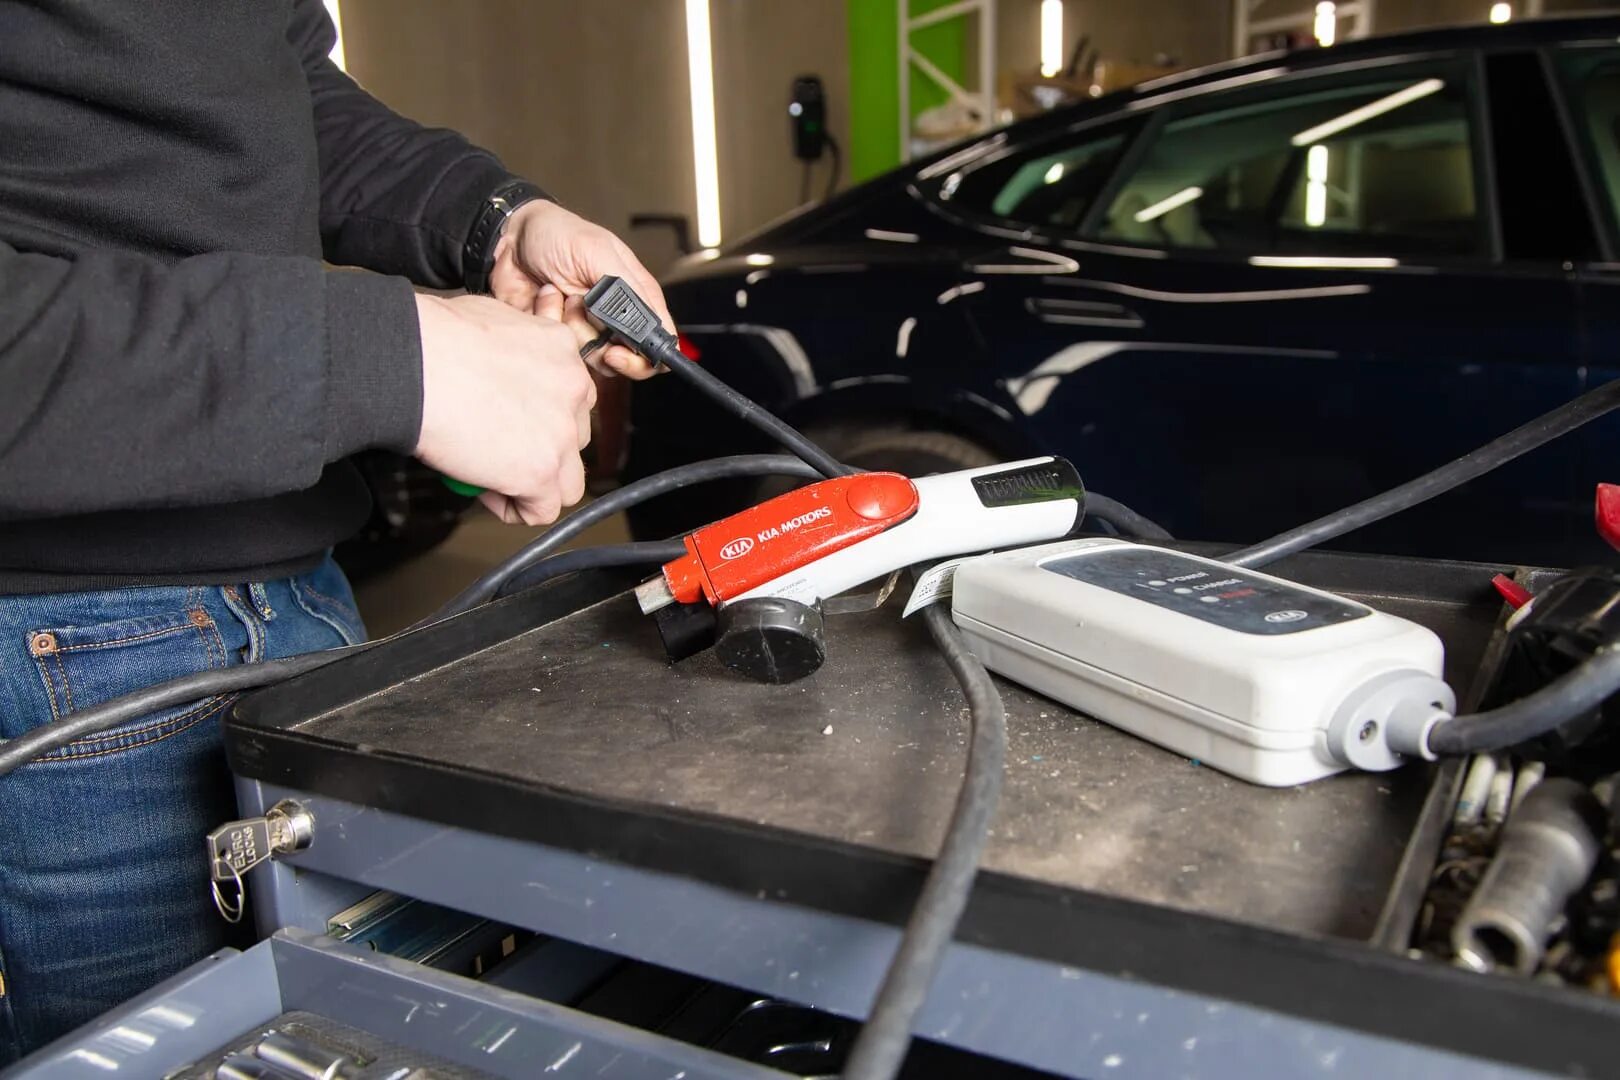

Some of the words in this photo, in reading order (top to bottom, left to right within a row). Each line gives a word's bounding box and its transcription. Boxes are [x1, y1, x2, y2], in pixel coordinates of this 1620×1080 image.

[757, 527, 780, 542] KIA
[781, 506, 832, 533] MOTORS
[723, 540, 751, 558] KIA
[231, 830, 246, 869] EURO
[243, 826, 257, 863] LOCKS
